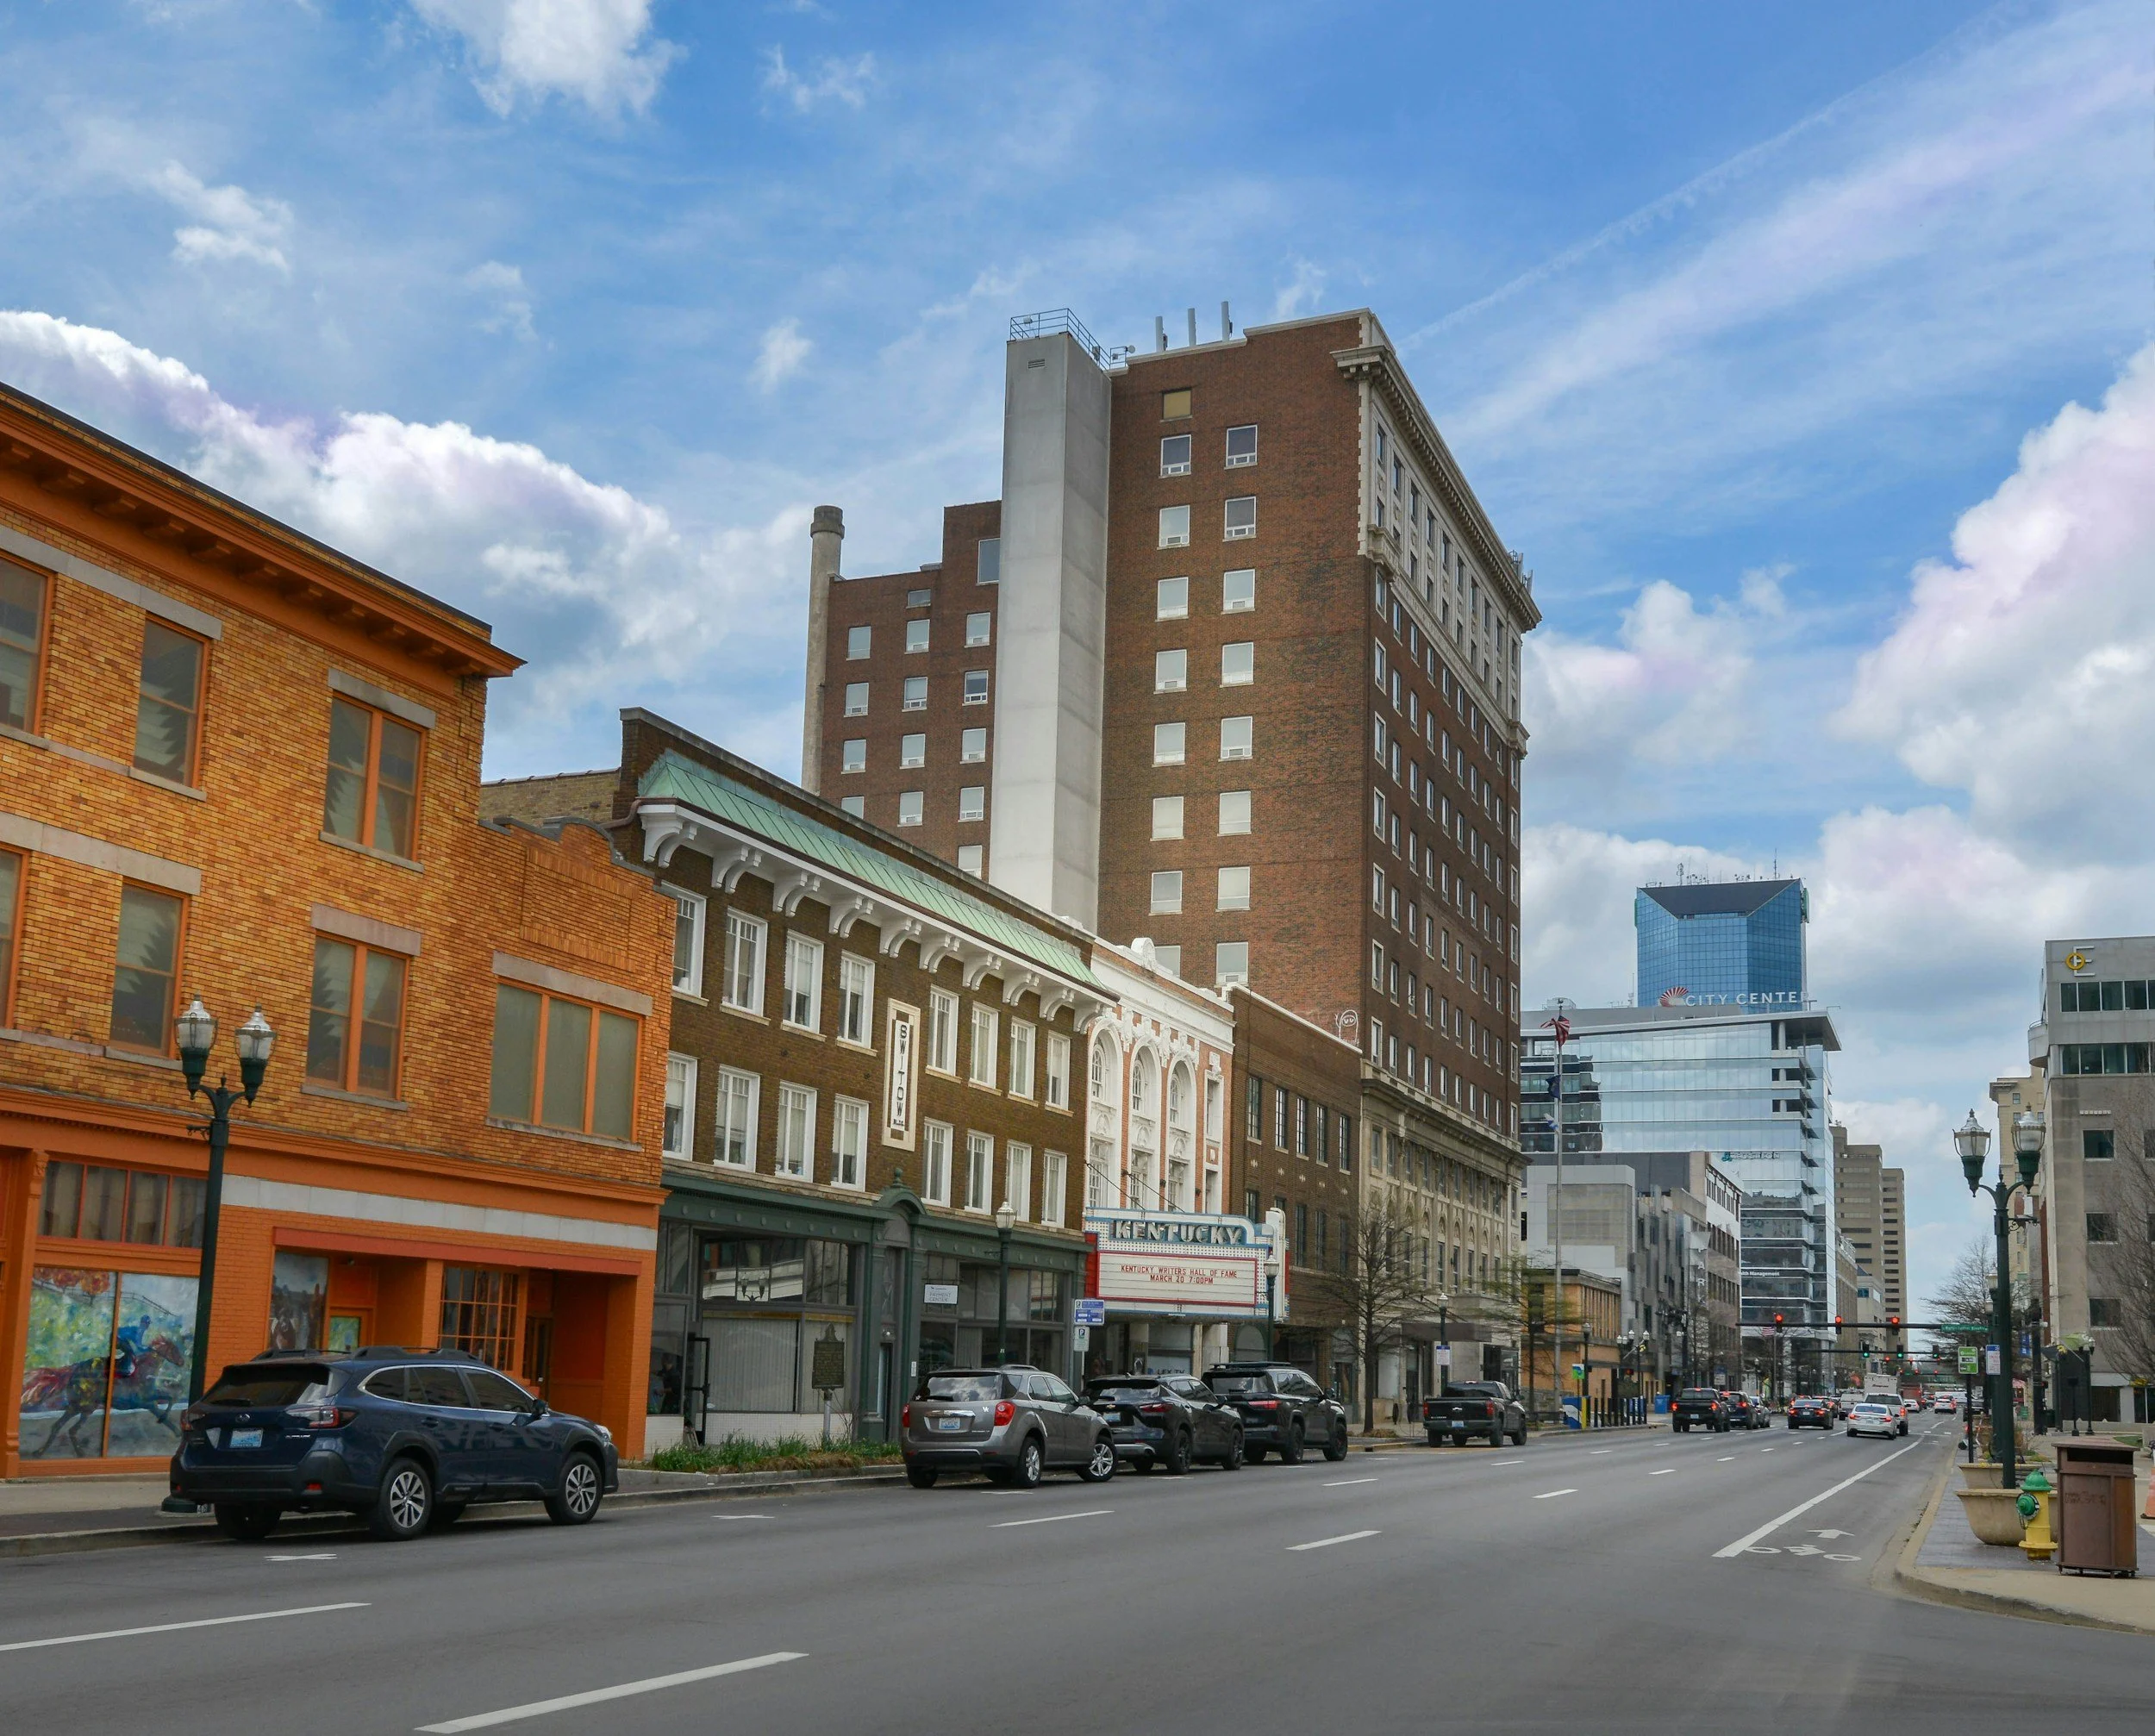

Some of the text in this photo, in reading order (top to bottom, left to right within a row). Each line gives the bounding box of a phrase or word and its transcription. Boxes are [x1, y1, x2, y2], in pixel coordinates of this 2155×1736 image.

[1685, 991, 1810, 1007] CITY CENTER
[896, 1024, 907, 1117] SWITOW
[1115, 1220, 1242, 1245] KENTUCKY
[1121, 1265, 1154, 1274] KENTUCKY
